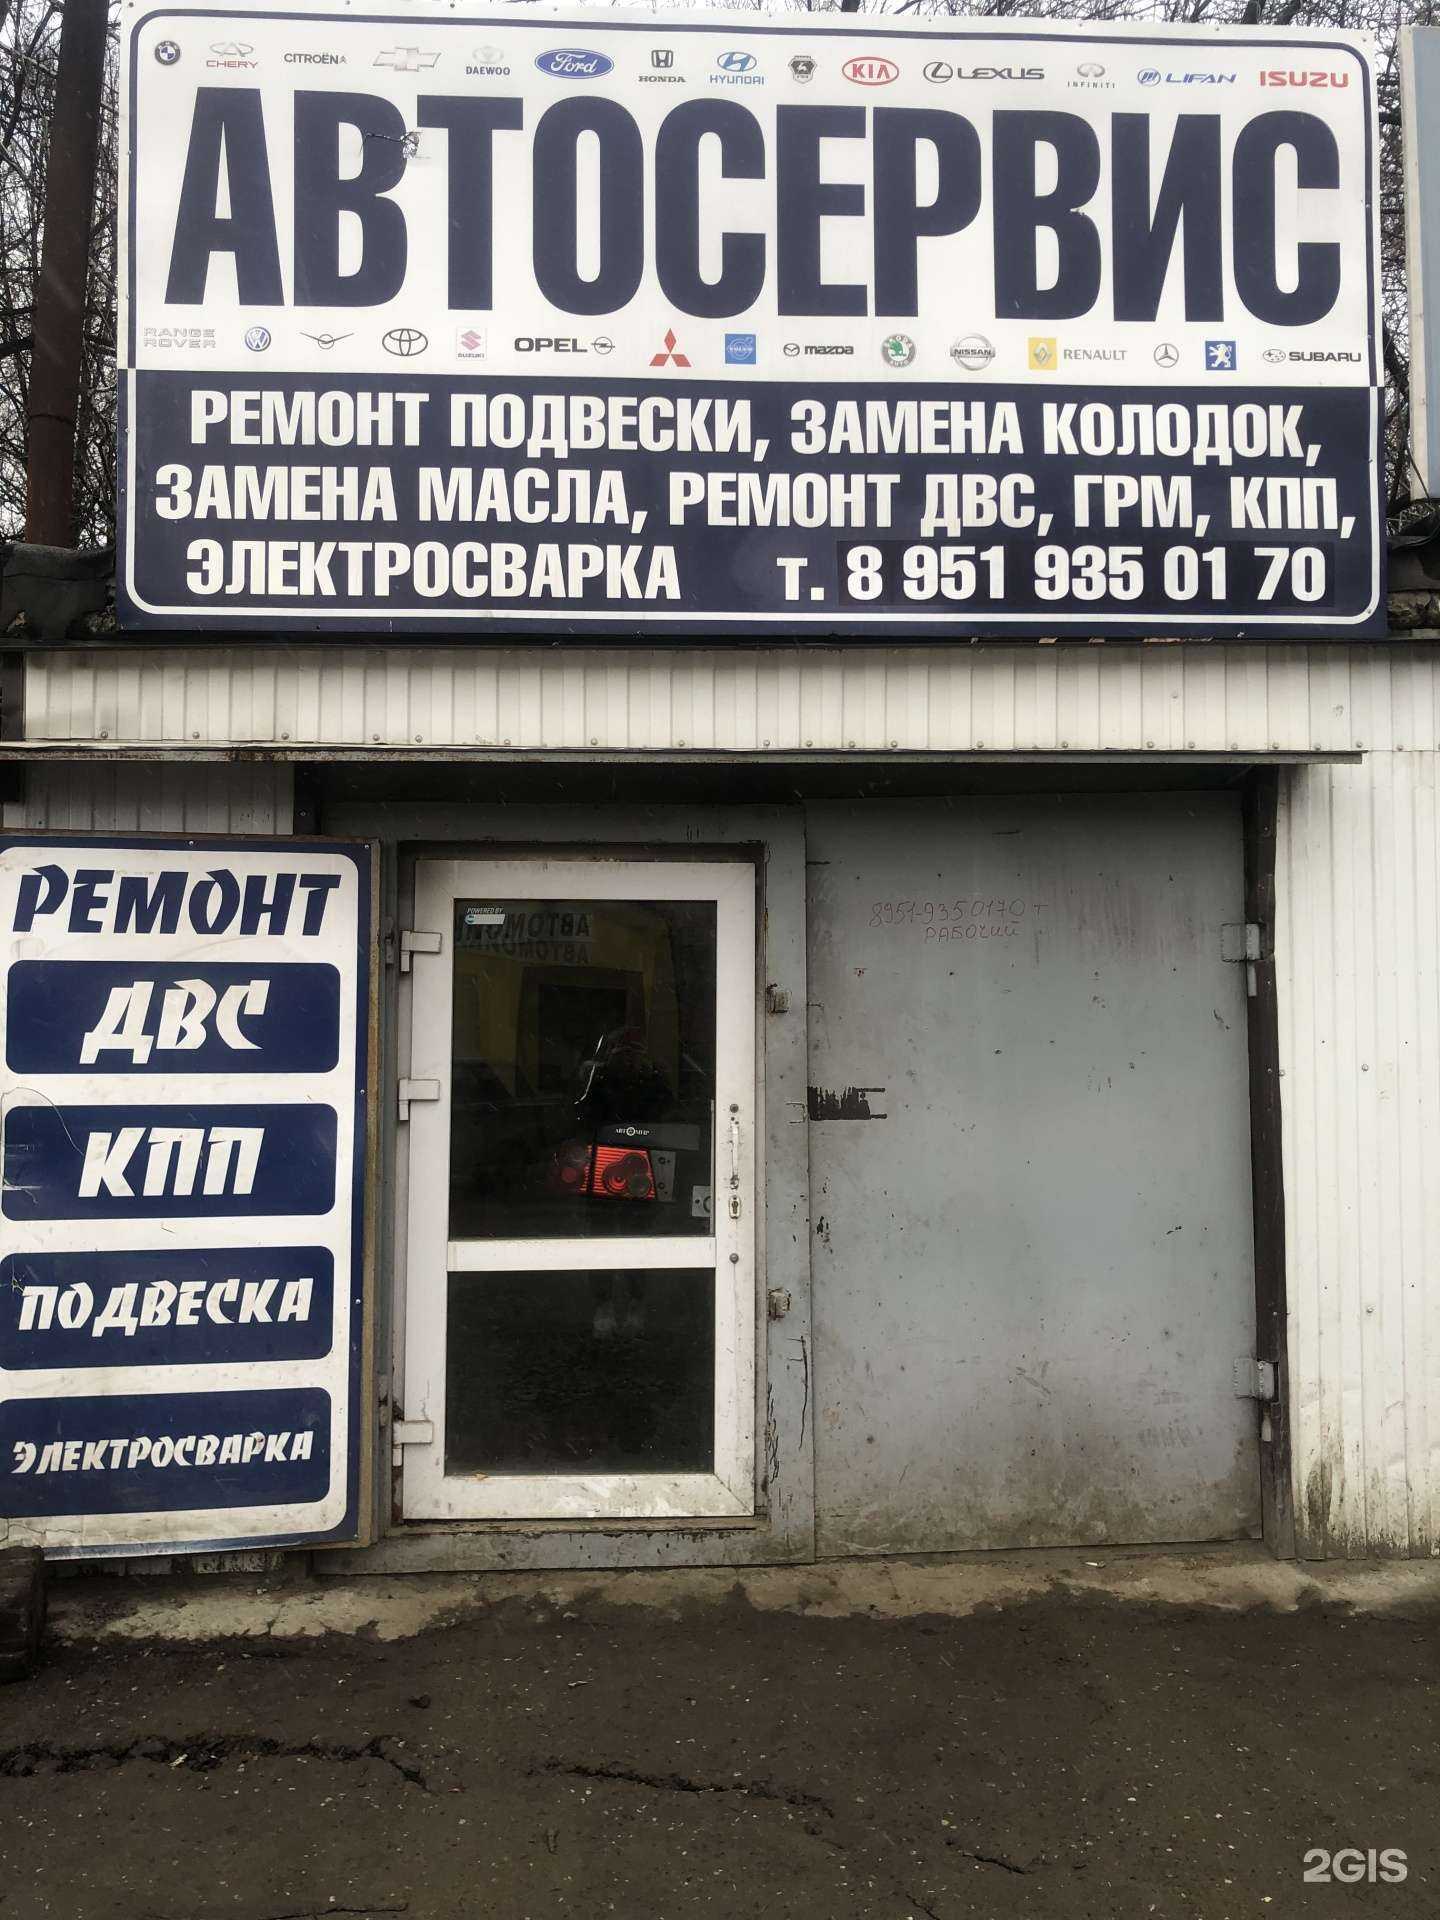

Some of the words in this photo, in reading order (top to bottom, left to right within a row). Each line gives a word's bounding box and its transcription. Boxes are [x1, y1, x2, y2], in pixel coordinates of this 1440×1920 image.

[206, 60, 259, 69] CHERY
[284, 53, 339, 65] CITROËN
[551, 52, 597, 73] Ford
[465, 66, 511, 76] DAEWOO
[852, 63, 891, 79] KIA
[957, 68, 1045, 80] LEXUS
[1165, 73, 1238, 83] LIFAN
[709, 75, 765, 85] HYUNDAI
[1067, 81, 1117, 89] INFINITI
[1259, 71, 1349, 88] ISUZU
[164, 86, 1341, 327] АВТОСЕРВИС
[144, 328, 216, 337] RANGE
[144, 338, 216, 349] ROVER
[514, 337, 588, 352] OPEL
[953, 348, 993, 357] NISSAN
[1063, 349, 1128, 361] RENAULT
[1288, 351, 1362, 362] SUBARU
[190, 390, 429, 447] РЕМОНТ
[450, 393, 769, 463] ПОДВЕСКИ,
[790, 399, 1024, 455] ЗАМЕНА
[1042, 403, 1322, 467] КОЛОДОК,
[155, 464, 398, 521] ЗАМЕНА
[418, 467, 648, 534] МАСЛА,
[669, 472, 900, 527] РЕМОНТ
[920, 474, 1054, 538] ДВС,
[1073, 475, 1210, 538] ГРМ,
[1230, 477, 1357, 539] КПП,
[185, 538, 682, 600] ЭЛЕКТРОСВАРКА
[846, 545, 883, 601] 8
[902, 545, 1005, 601] 951
[1033, 545, 1144, 601] 935
[1162, 547, 1227, 602] 01
[1253, 547, 1326, 602] 70
[12, 864, 341, 936] РЕМОНТ
[79, 977, 271, 1065] ДВС
[78, 1127, 265, 1197] КПП
[18, 1277, 314, 1336] ПОДВЕСКА
[12, 1430, 314, 1474] ЭЛЕКТРОСВАРКА
